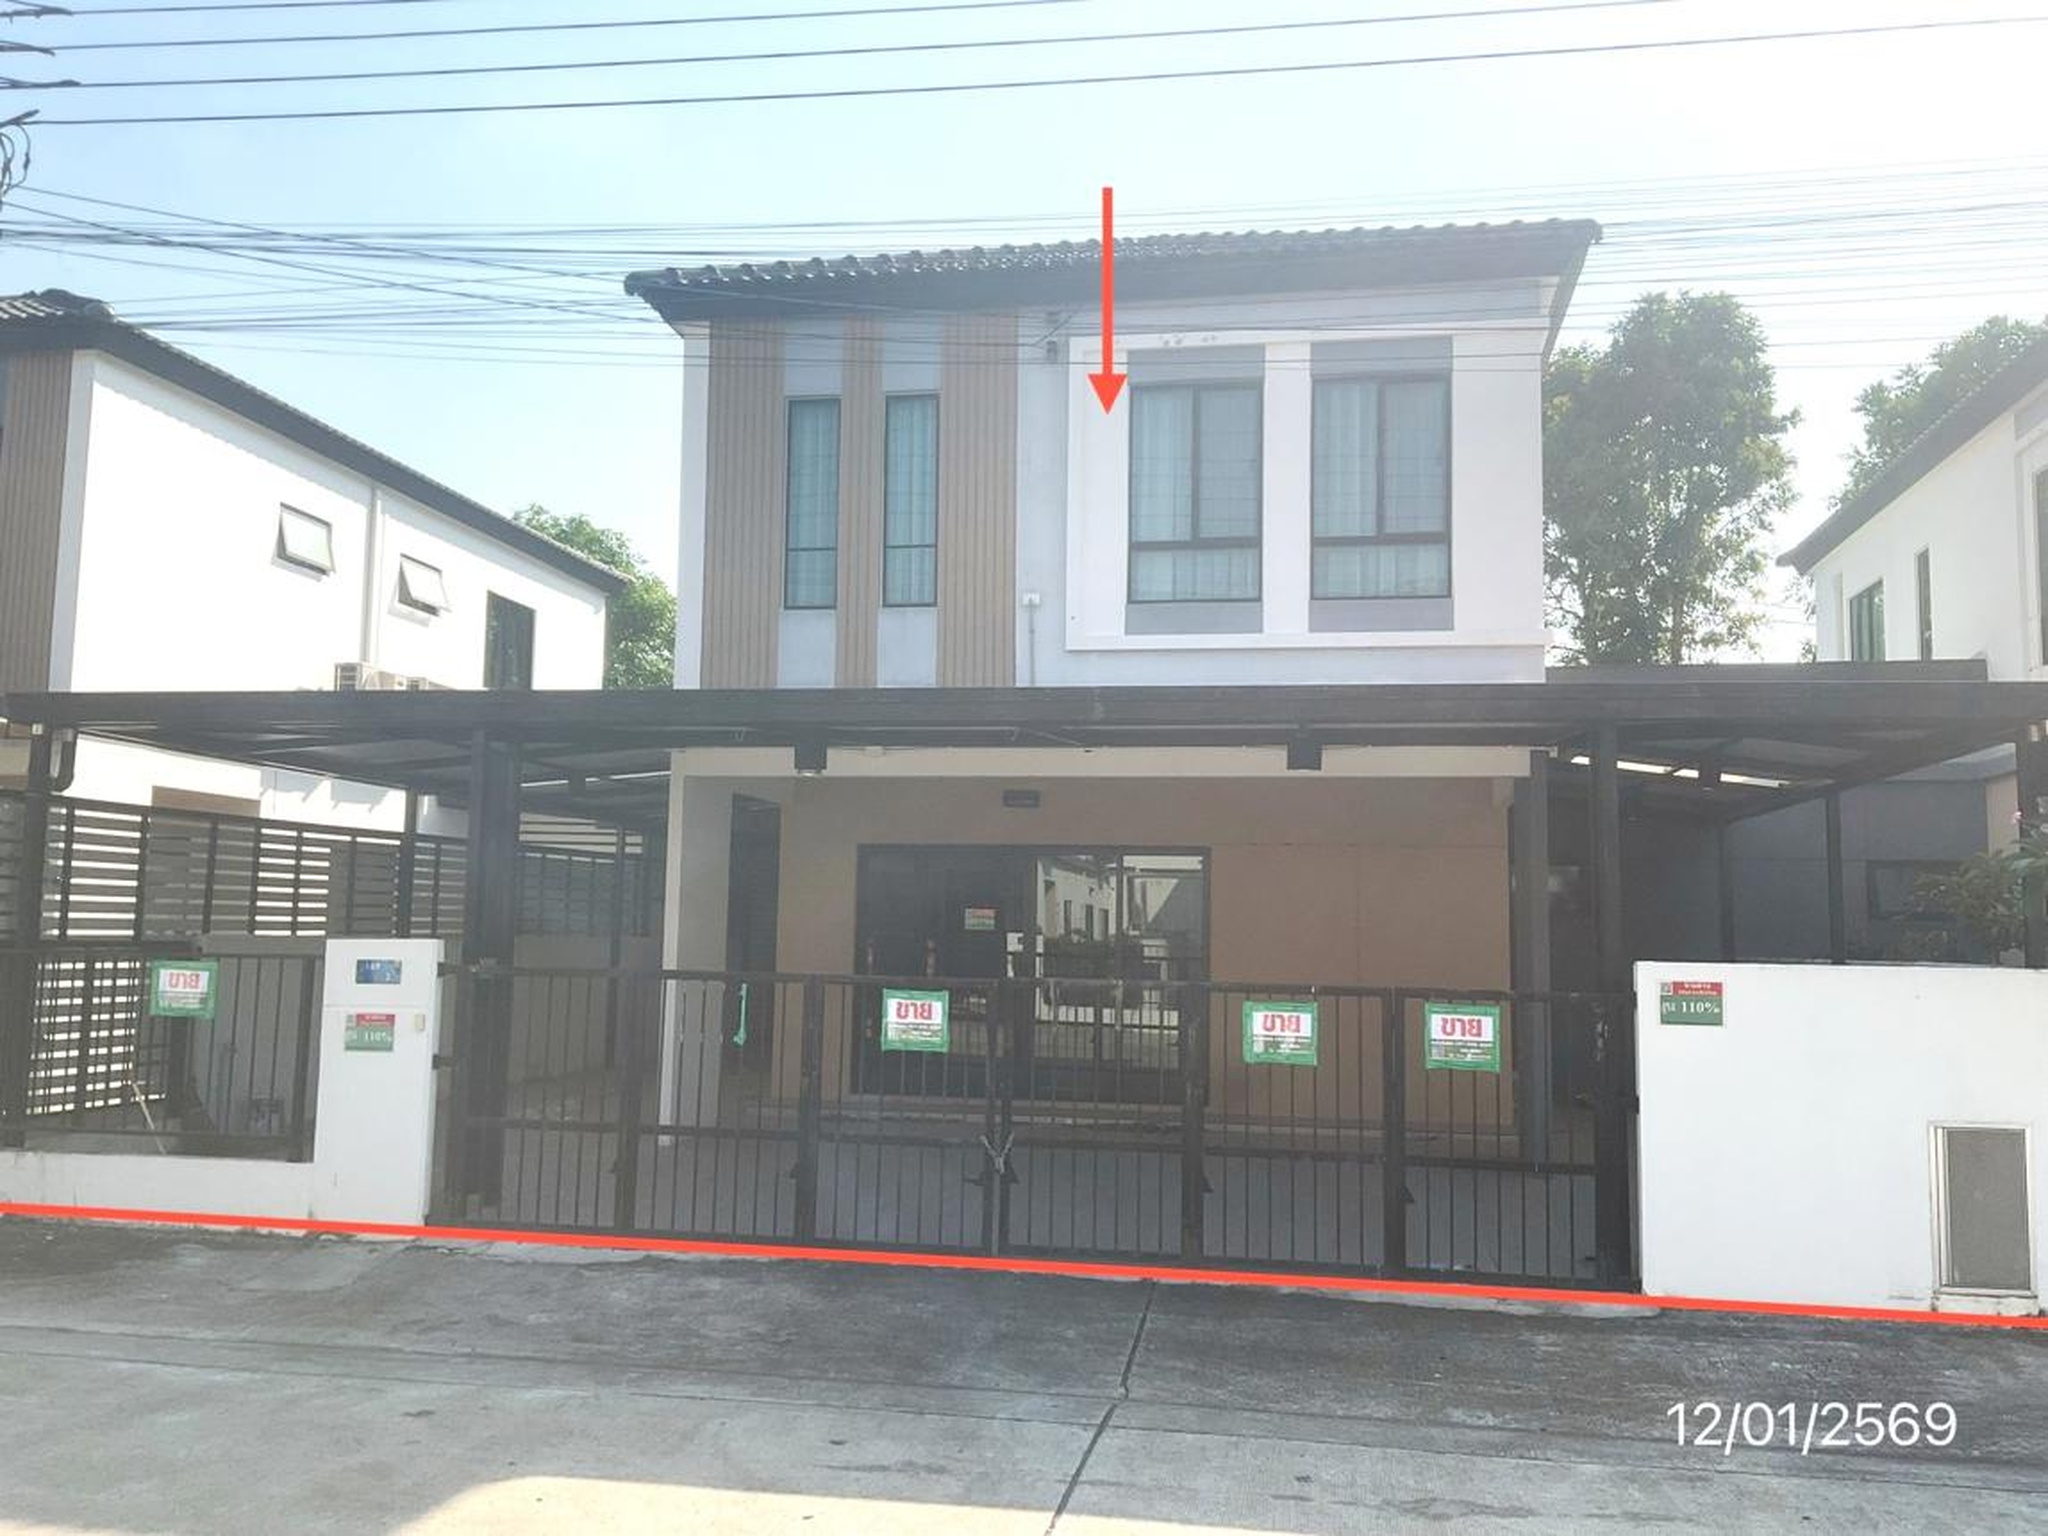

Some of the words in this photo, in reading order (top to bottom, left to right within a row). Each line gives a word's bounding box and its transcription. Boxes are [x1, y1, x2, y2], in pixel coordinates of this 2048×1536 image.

[896, 1001, 933, 1021] ขาย
[1682, 1001, 1720, 1014] 110%
[1263, 1014, 1301, 1033] ขาย
[1441, 1017, 1482, 1037] ขาย
